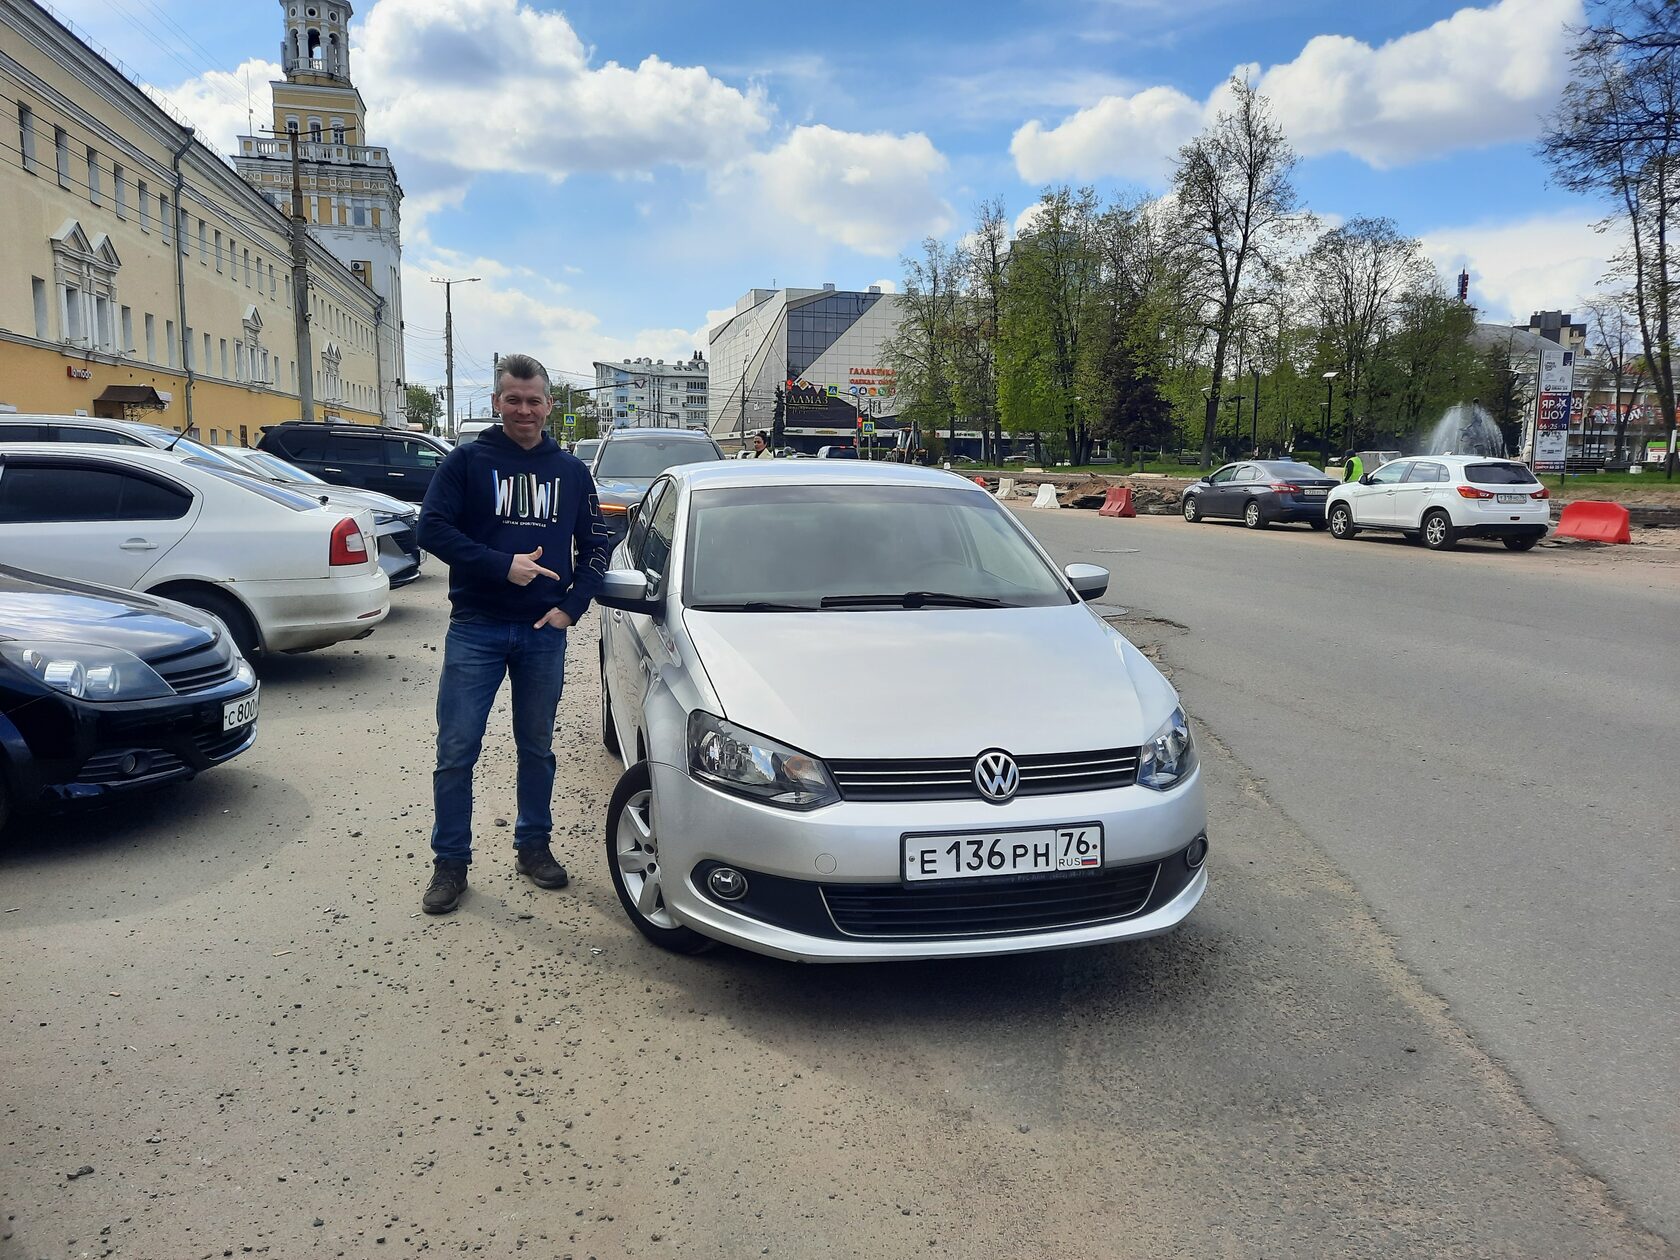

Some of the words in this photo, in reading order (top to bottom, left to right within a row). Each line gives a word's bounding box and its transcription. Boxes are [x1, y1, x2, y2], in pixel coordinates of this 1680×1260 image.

[1541, 400, 1556, 409] ЯР
[1540, 410, 1566, 420] ШОУ
[492, 469, 560, 523] WOW!
[1060, 831, 1091, 857] 76
[1058, 857, 1081, 867] RUS
